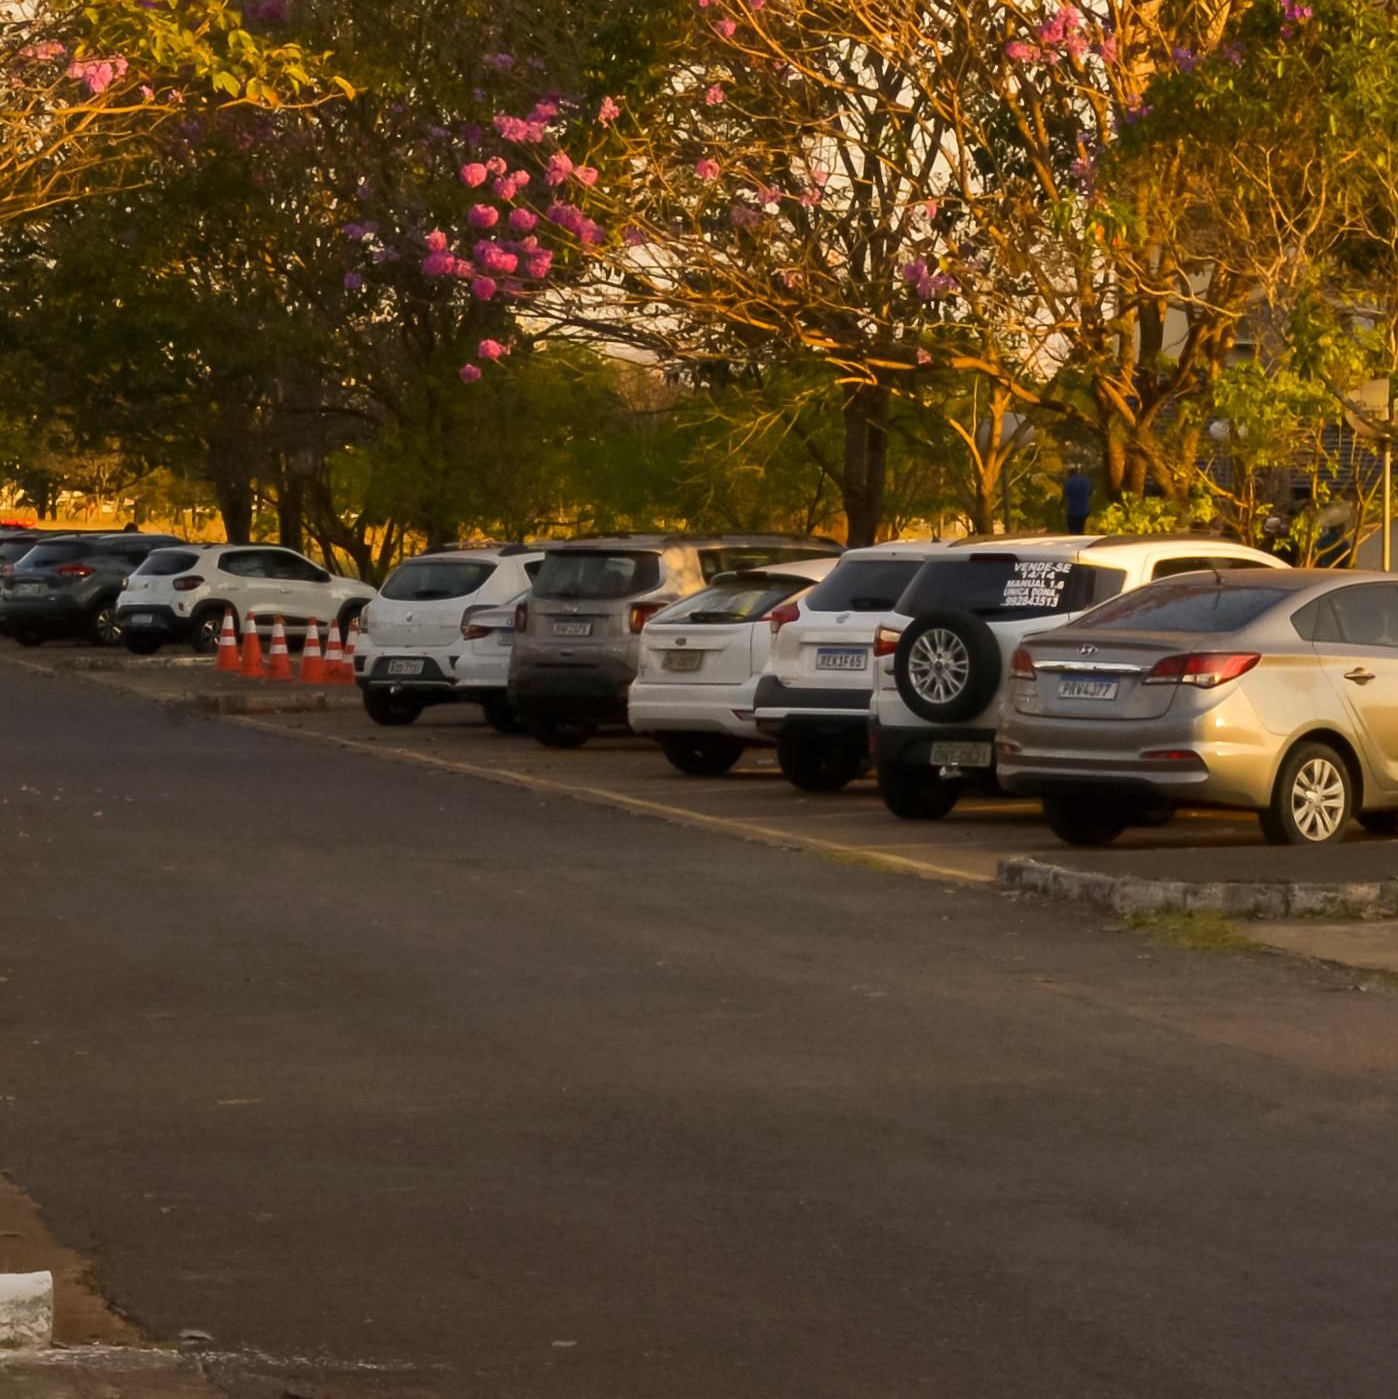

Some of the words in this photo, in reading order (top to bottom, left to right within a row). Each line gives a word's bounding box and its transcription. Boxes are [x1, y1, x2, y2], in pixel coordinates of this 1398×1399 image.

[1014, 562, 1072, 573] VENDE-SE
[1021, 571, 1056, 579] 14/14
[1006, 579, 1046, 588] MANUAL
